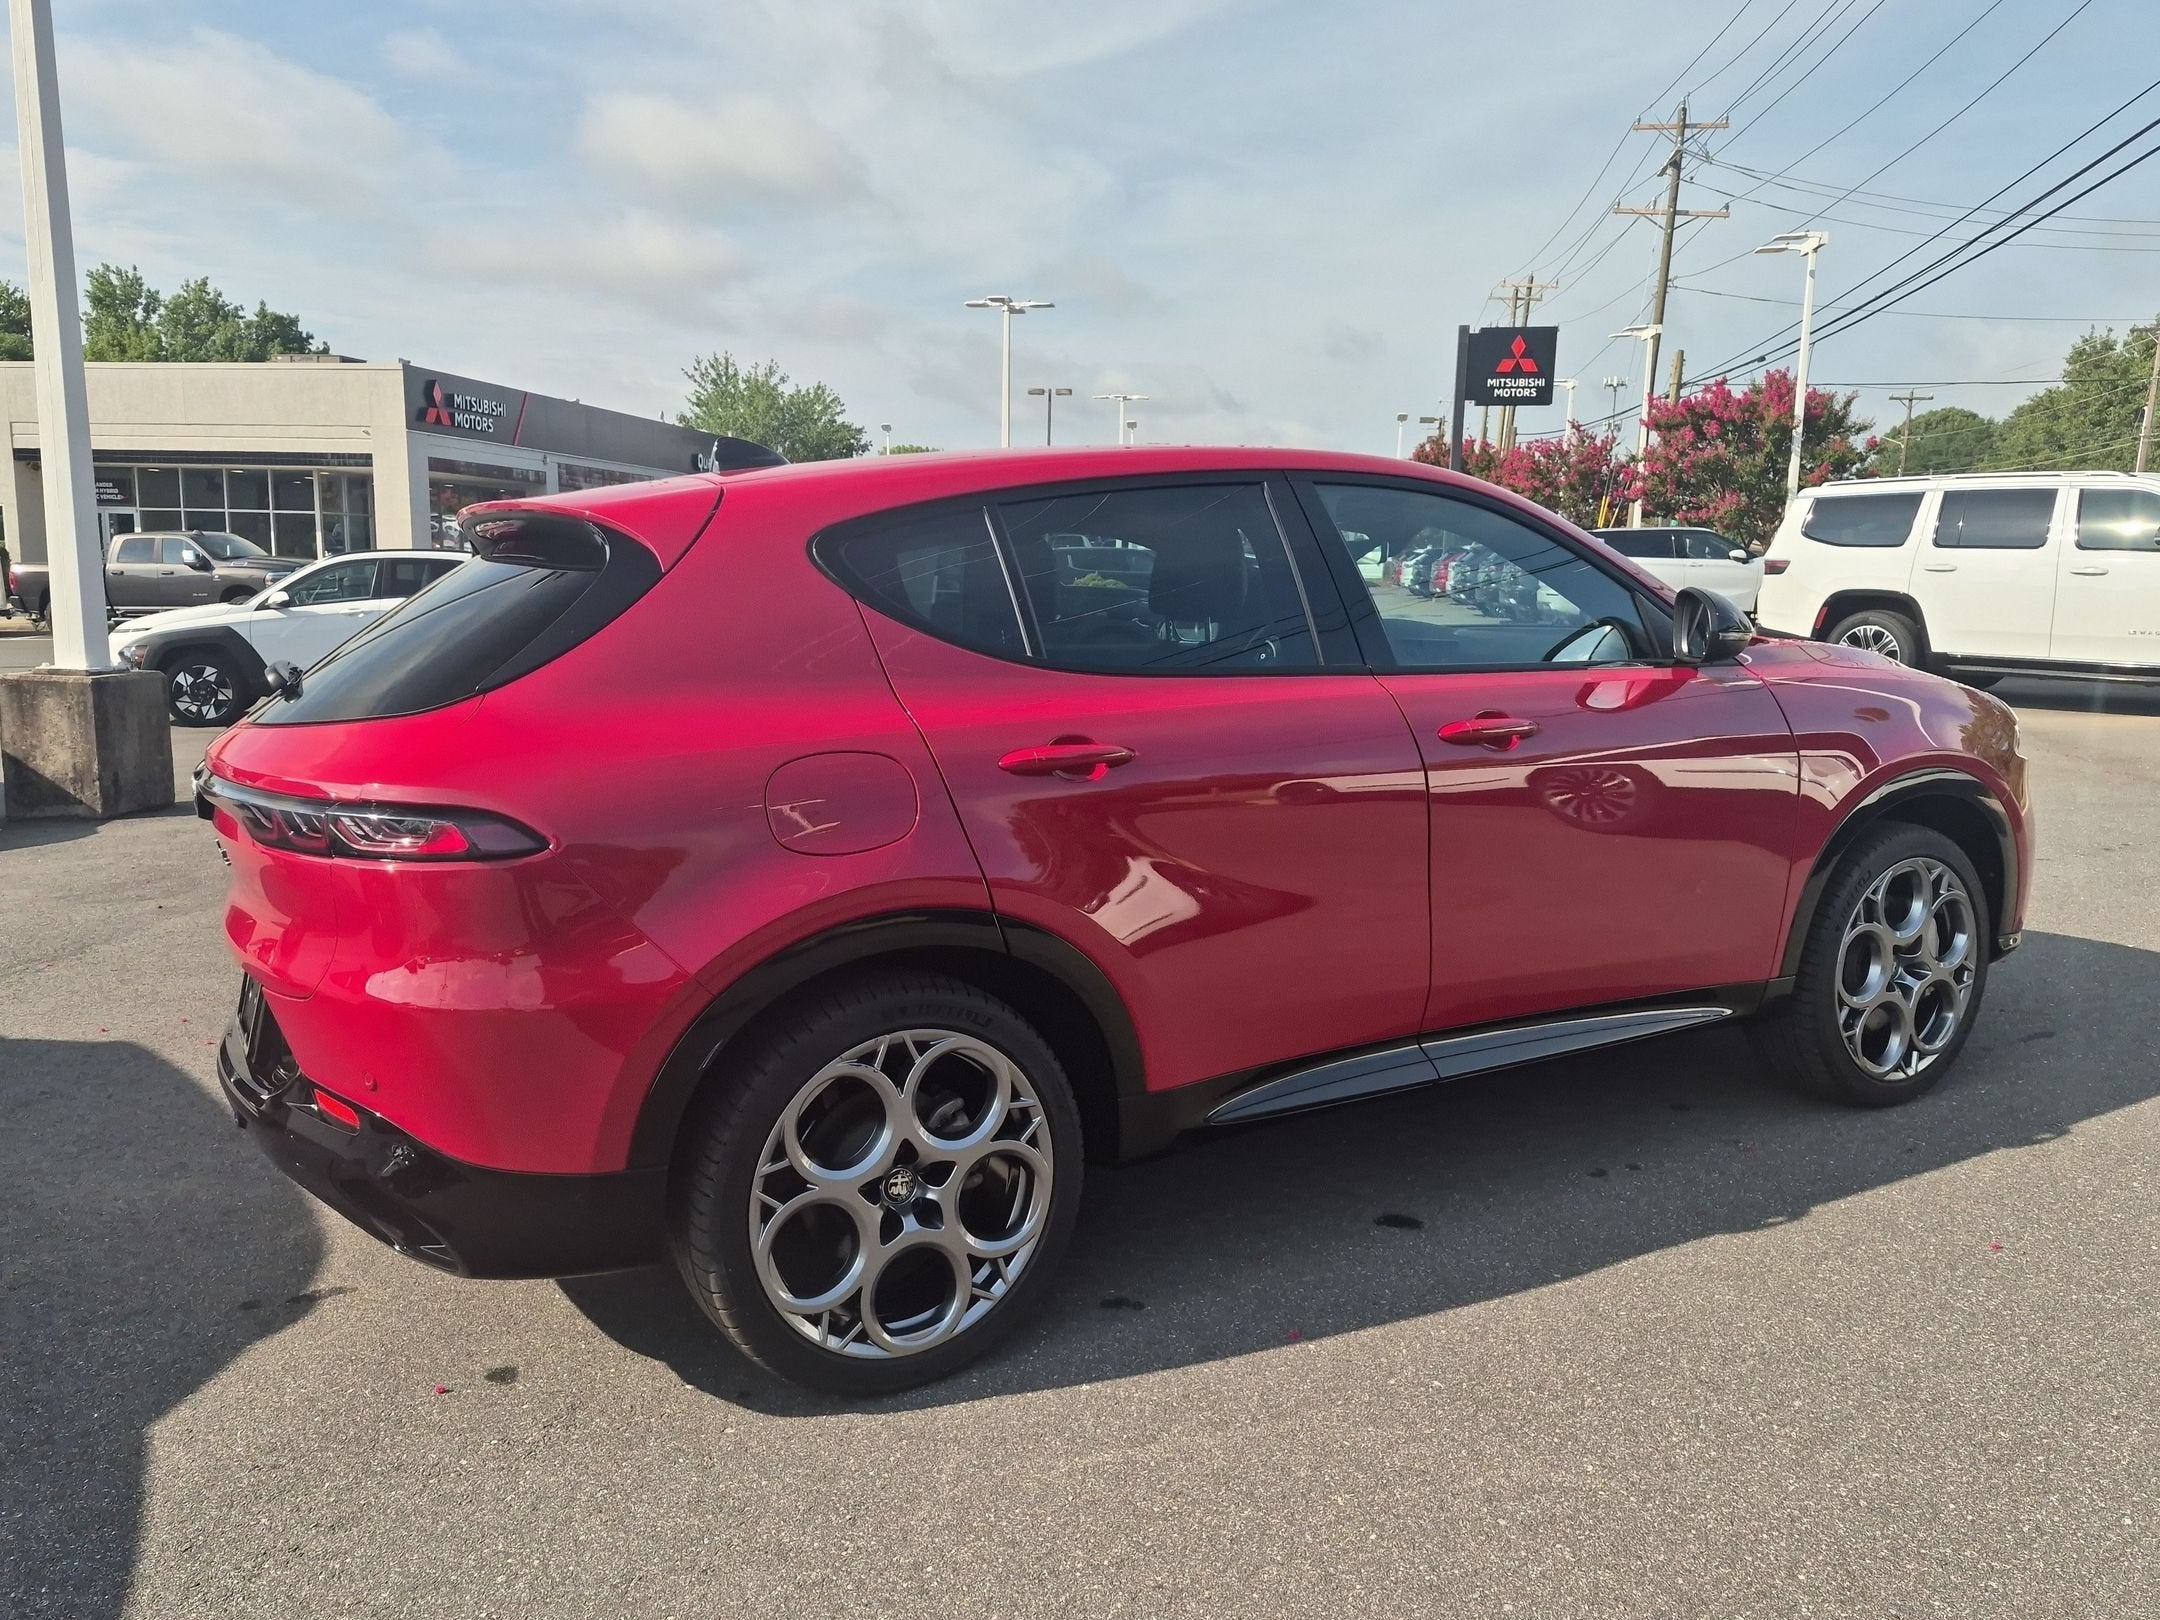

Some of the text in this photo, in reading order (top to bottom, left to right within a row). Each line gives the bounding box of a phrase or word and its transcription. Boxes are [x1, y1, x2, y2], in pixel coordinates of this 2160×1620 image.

[1487, 378, 1545, 387] MITSUBISHI
[1494, 388, 1537, 397] MOTORS
[454, 393, 506, 417] MITSUBISHI
[454, 412, 494, 433] MOTORS
